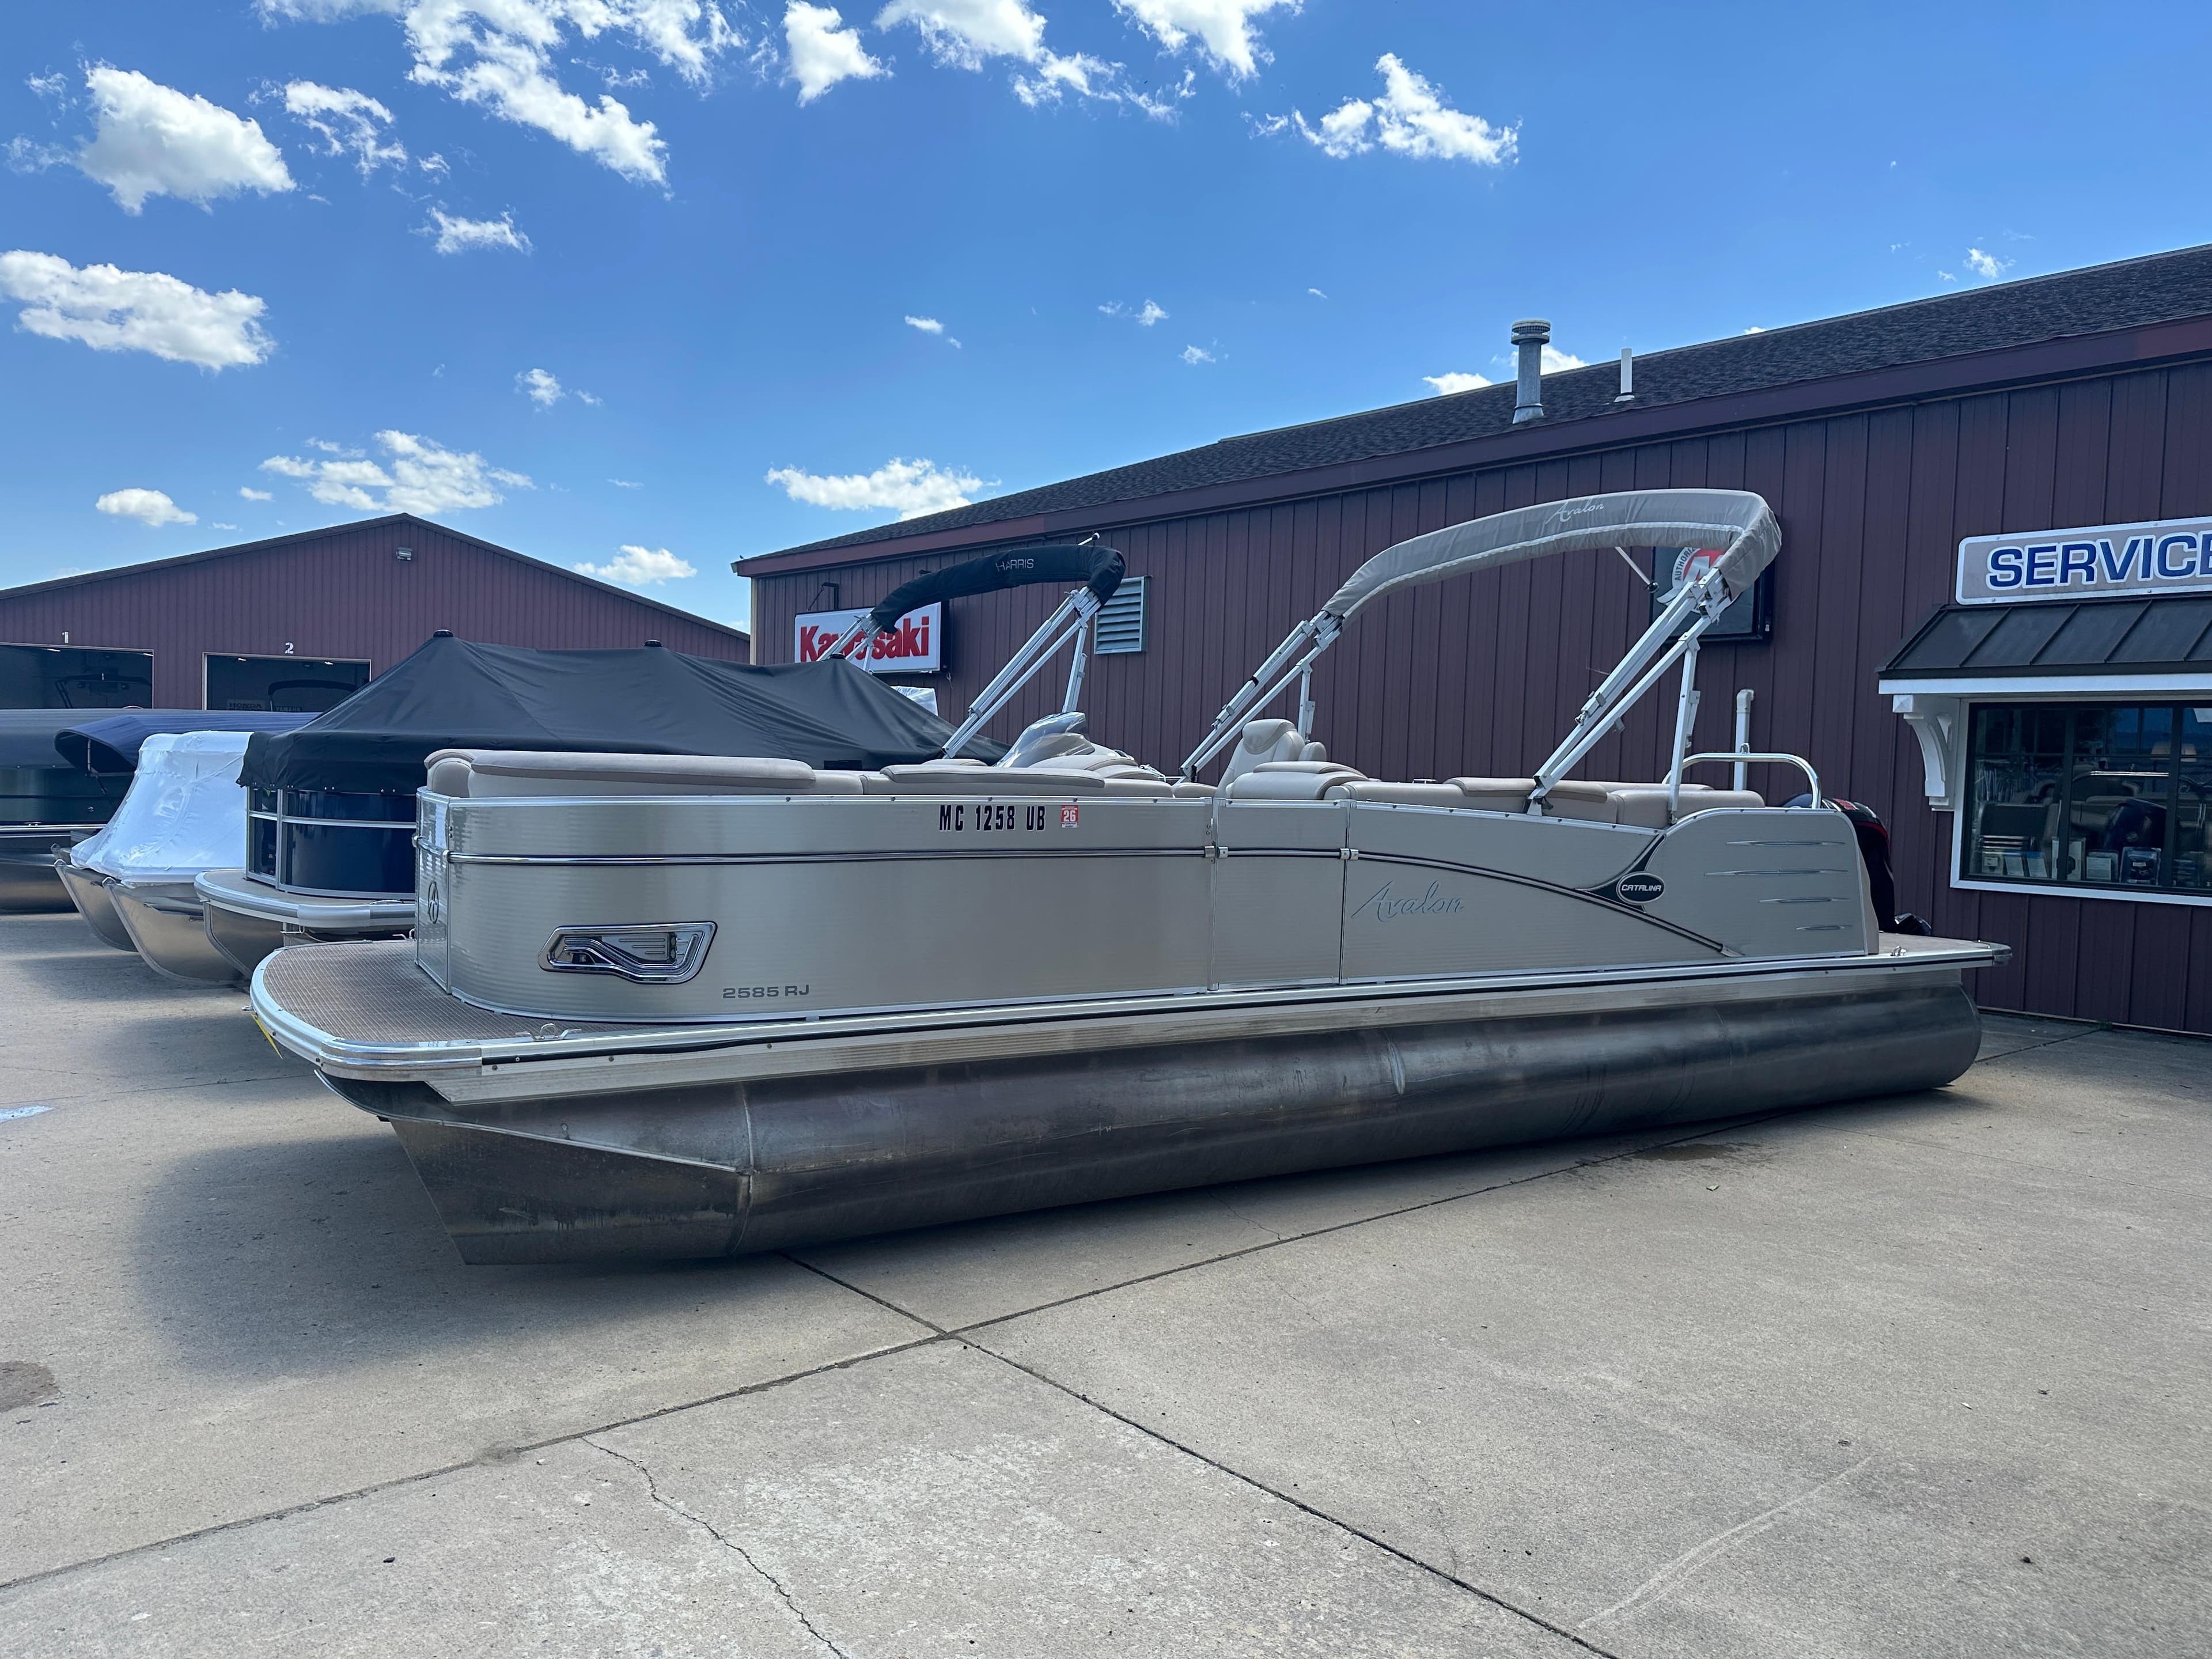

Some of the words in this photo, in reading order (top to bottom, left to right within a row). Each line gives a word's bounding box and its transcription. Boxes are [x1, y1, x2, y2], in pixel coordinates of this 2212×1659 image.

[1544, 498, 1605, 522] Avalon
[995, 558, 1035, 572] HARRIS
[62, 631, 69, 643] 1
[285, 642, 294, 654] 2
[939, 805, 964, 831] MC
[975, 805, 1016, 831] 1258
[1025, 805, 1046, 831] UB
[1063, 810, 1076, 822] 26
[1351, 880, 1465, 922] Avalon
[722, 986, 779, 999] 2585
[785, 984, 810, 997] RJ
